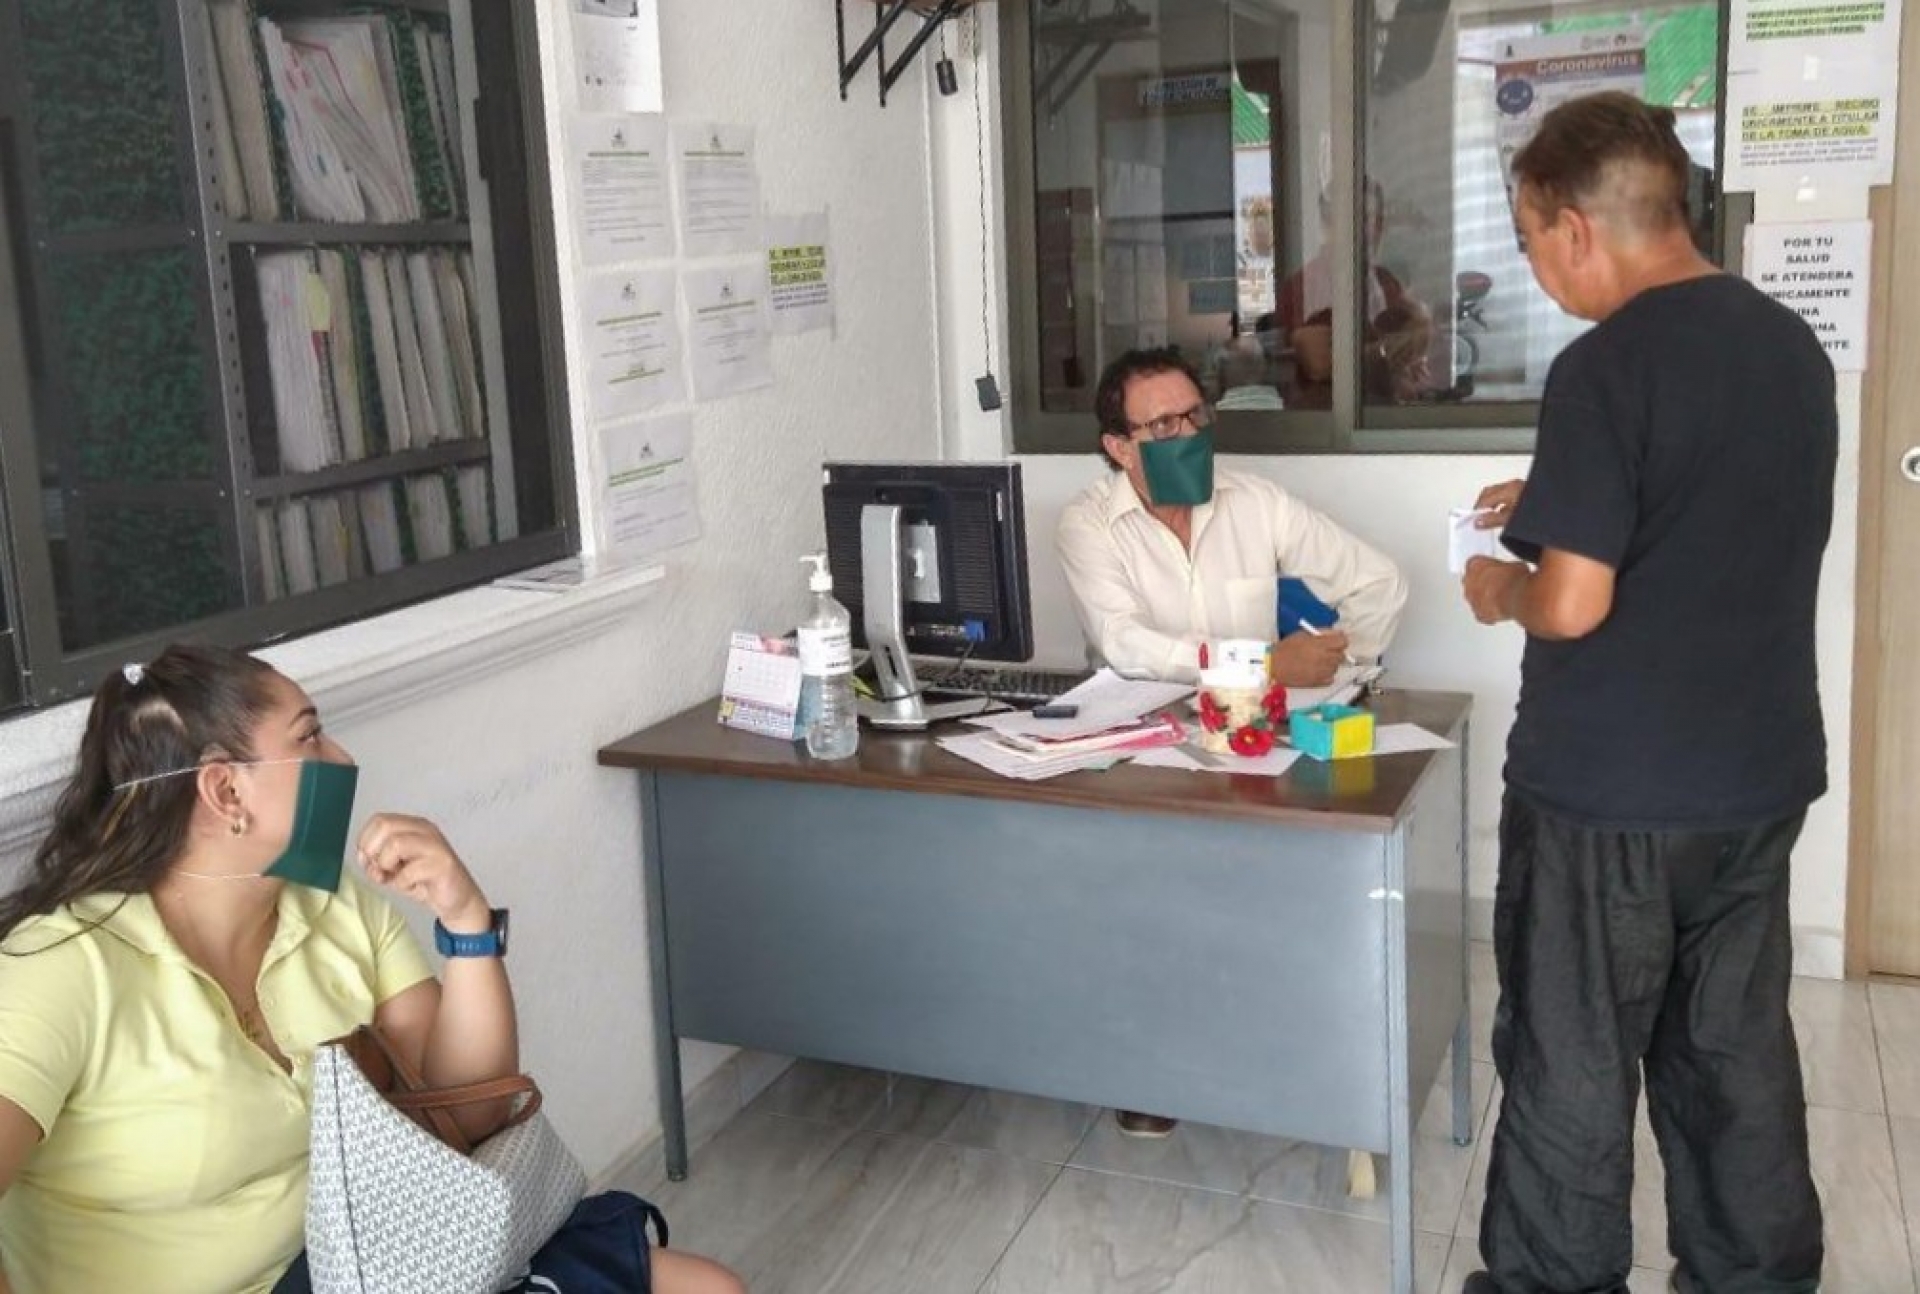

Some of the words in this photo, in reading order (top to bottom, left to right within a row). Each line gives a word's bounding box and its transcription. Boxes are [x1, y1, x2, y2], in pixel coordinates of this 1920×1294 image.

[1537, 53, 1639, 75] Coronavirus
[1784, 238, 1811, 248] POR
[1815, 236, 1833, 247] TU
[1787, 254, 1830, 264] SALUD
[1761, 272, 1777, 282] SE
[1782, 271, 1853, 282] ATENDERA
